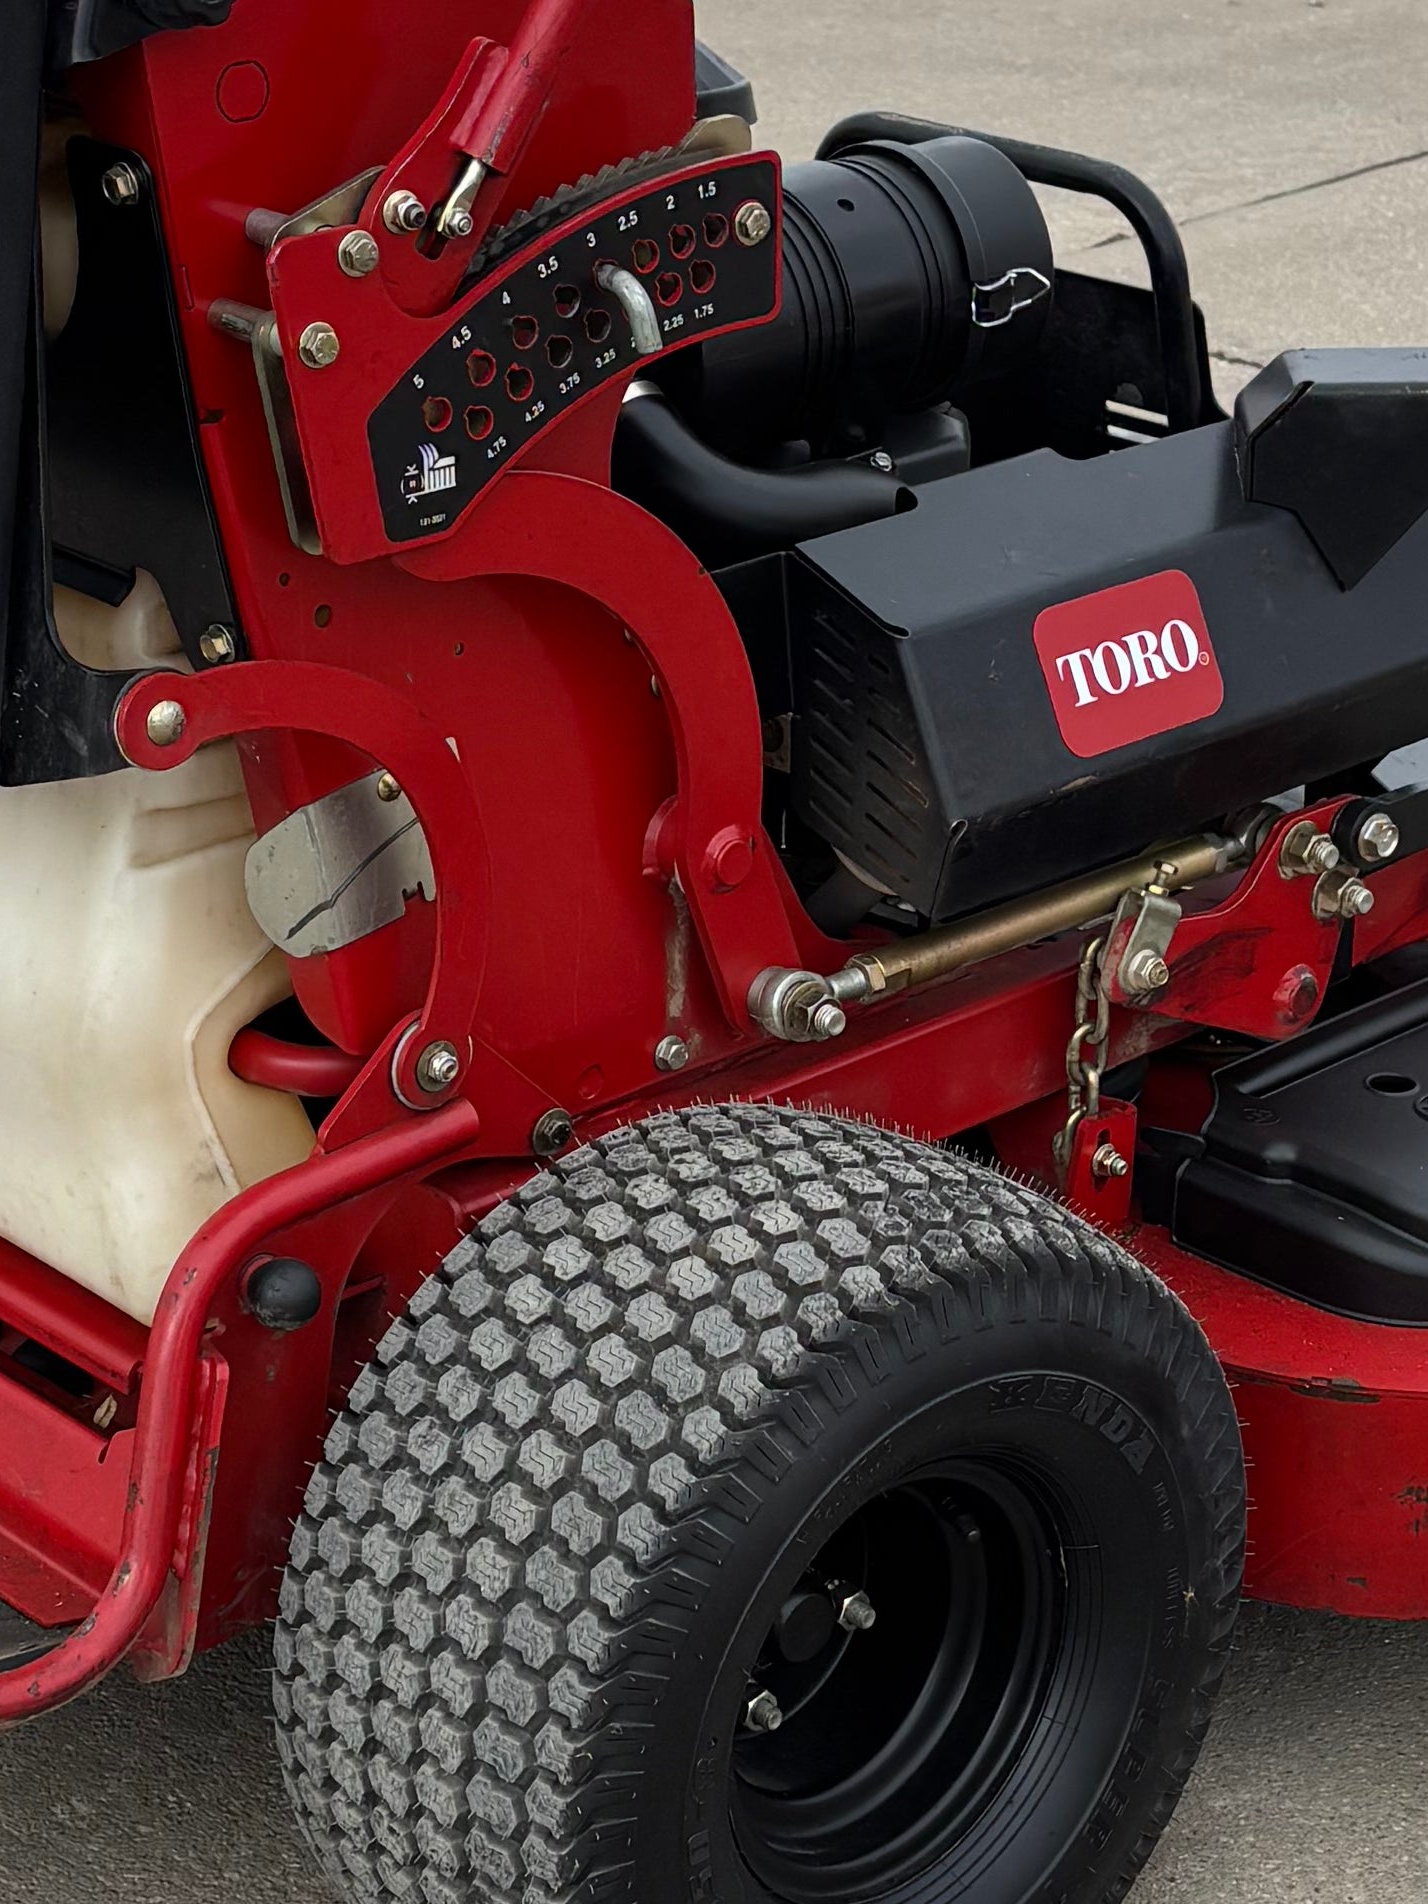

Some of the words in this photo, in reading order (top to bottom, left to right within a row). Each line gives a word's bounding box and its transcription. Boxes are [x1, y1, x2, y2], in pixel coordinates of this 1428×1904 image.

[412, 374, 425, 389] 5
[452, 325, 472, 349] 4.5
[502, 291, 511, 304] 4
[537, 255, 559, 279] 3.5
[586, 232, 597, 247] 3
[618, 210, 639, 232] 2.5
[665, 195, 675, 211] 2
[698, 181, 717, 200] 1.5
[486, 435, 508, 460] 4.75
[524, 400, 546, 424] 4.25
[558, 372, 581, 395] 3.75
[594, 348, 617, 369] 3.25
[663, 313, 685, 332] 2.25
[693, 302, 715, 319] 1.75
[1056, 619, 1199, 707] TORO
